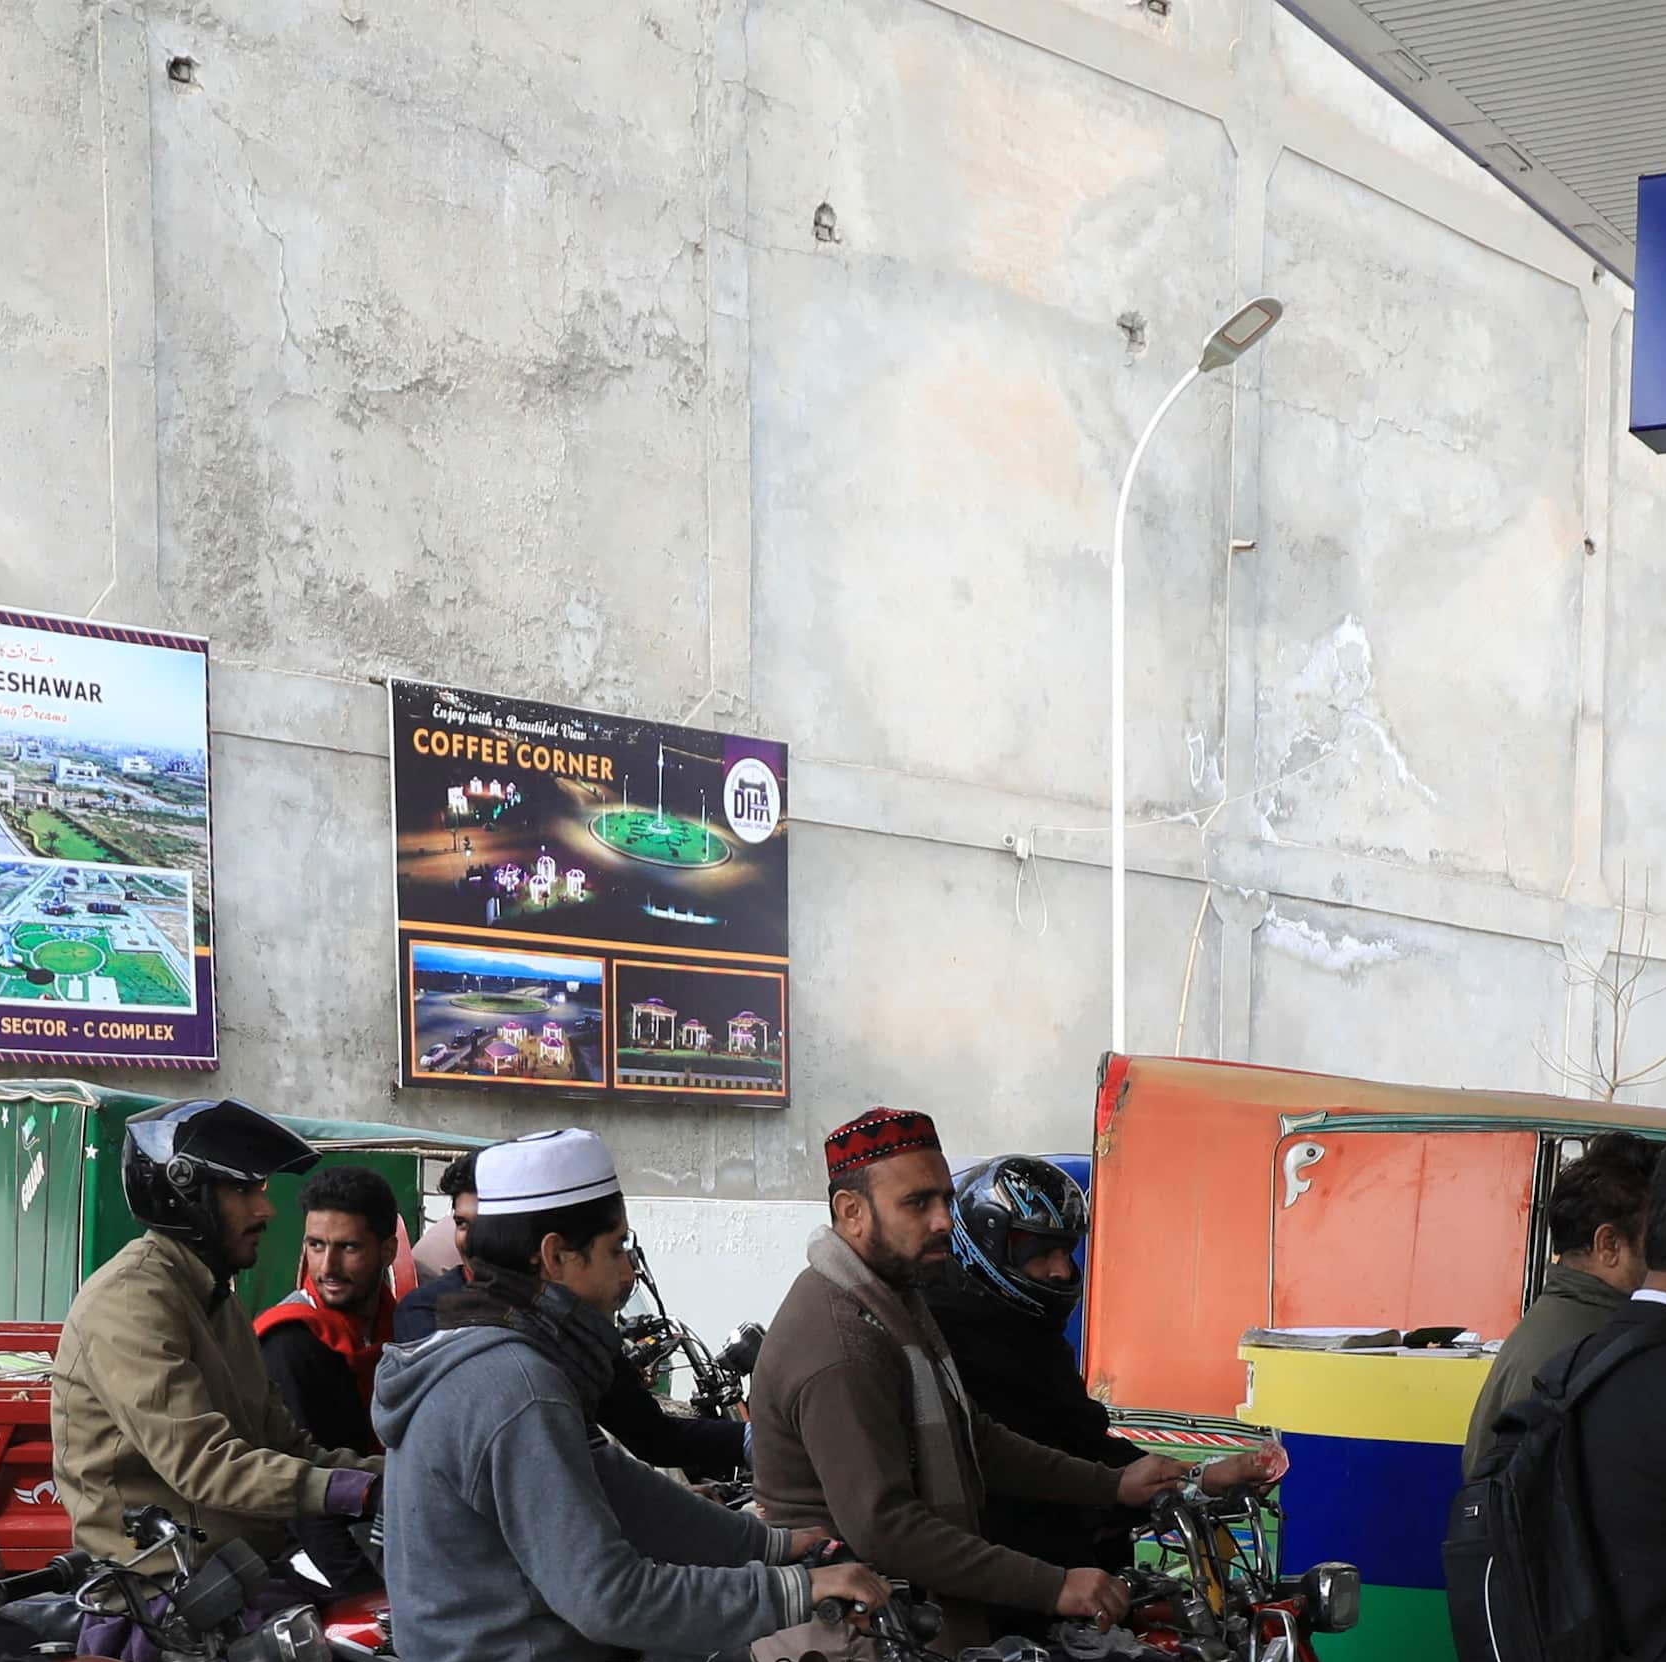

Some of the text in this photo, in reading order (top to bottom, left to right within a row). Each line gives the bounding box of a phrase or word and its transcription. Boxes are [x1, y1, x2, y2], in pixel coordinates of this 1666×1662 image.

[21, 703, 68, 722] Dreams
[432, 703, 587, 741] Enjoy with a Beautiful View
[412, 727, 614, 781] COFFEE CORNER
[734, 789, 771, 823] DHA
[0, 1017, 68, 1037] SECTOR
[83, 1021, 95, 1038] C
[98, 1022, 174, 1041] COMPLEX
